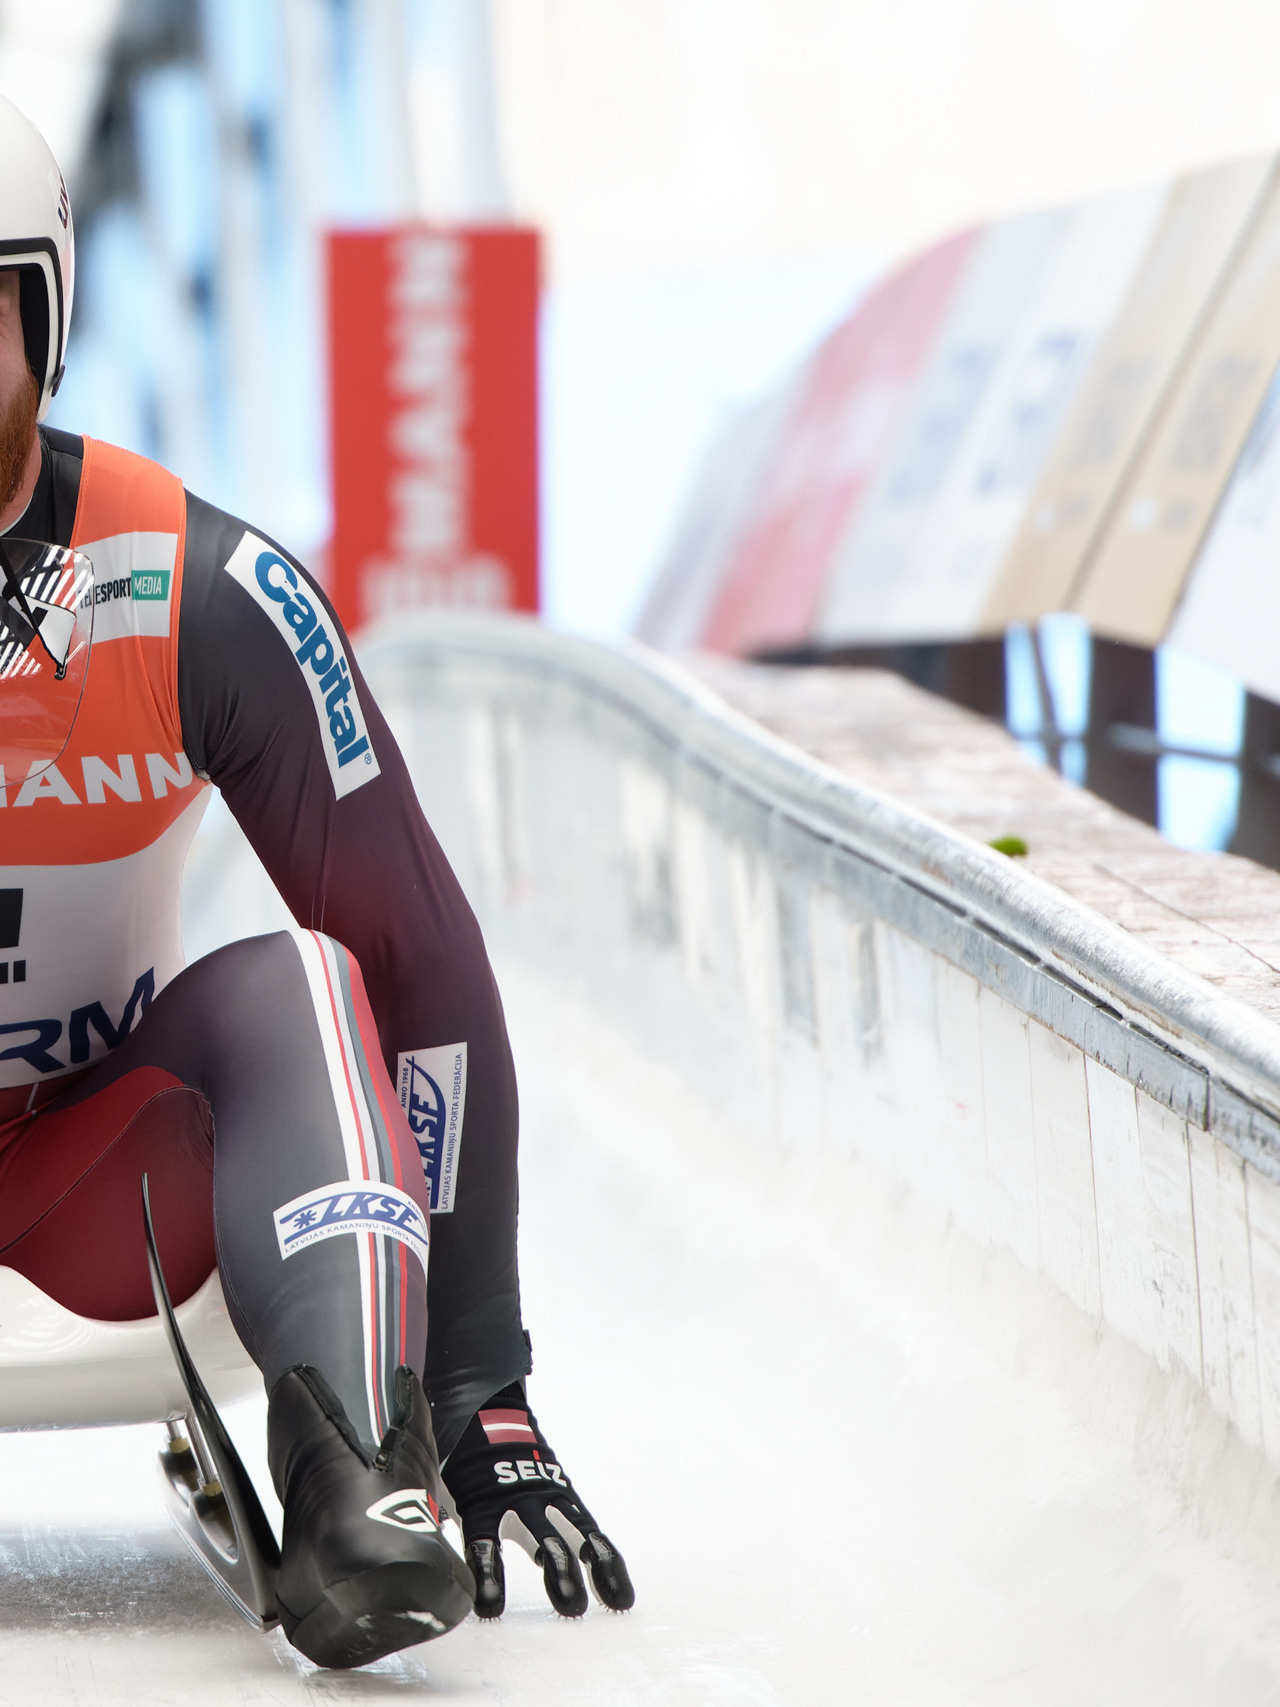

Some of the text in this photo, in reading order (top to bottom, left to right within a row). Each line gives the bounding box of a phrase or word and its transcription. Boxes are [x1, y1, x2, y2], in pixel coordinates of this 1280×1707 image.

[134, 575, 162, 595] MEDIA
[255, 551, 370, 768] Capital
[442, 1176, 452, 1210] LATVIJAS
[450, 1101, 459, 1131] SPORTA
[321, 1192, 419, 1226] LKSE
[285, 1230, 324, 1254] LATVIJAS
